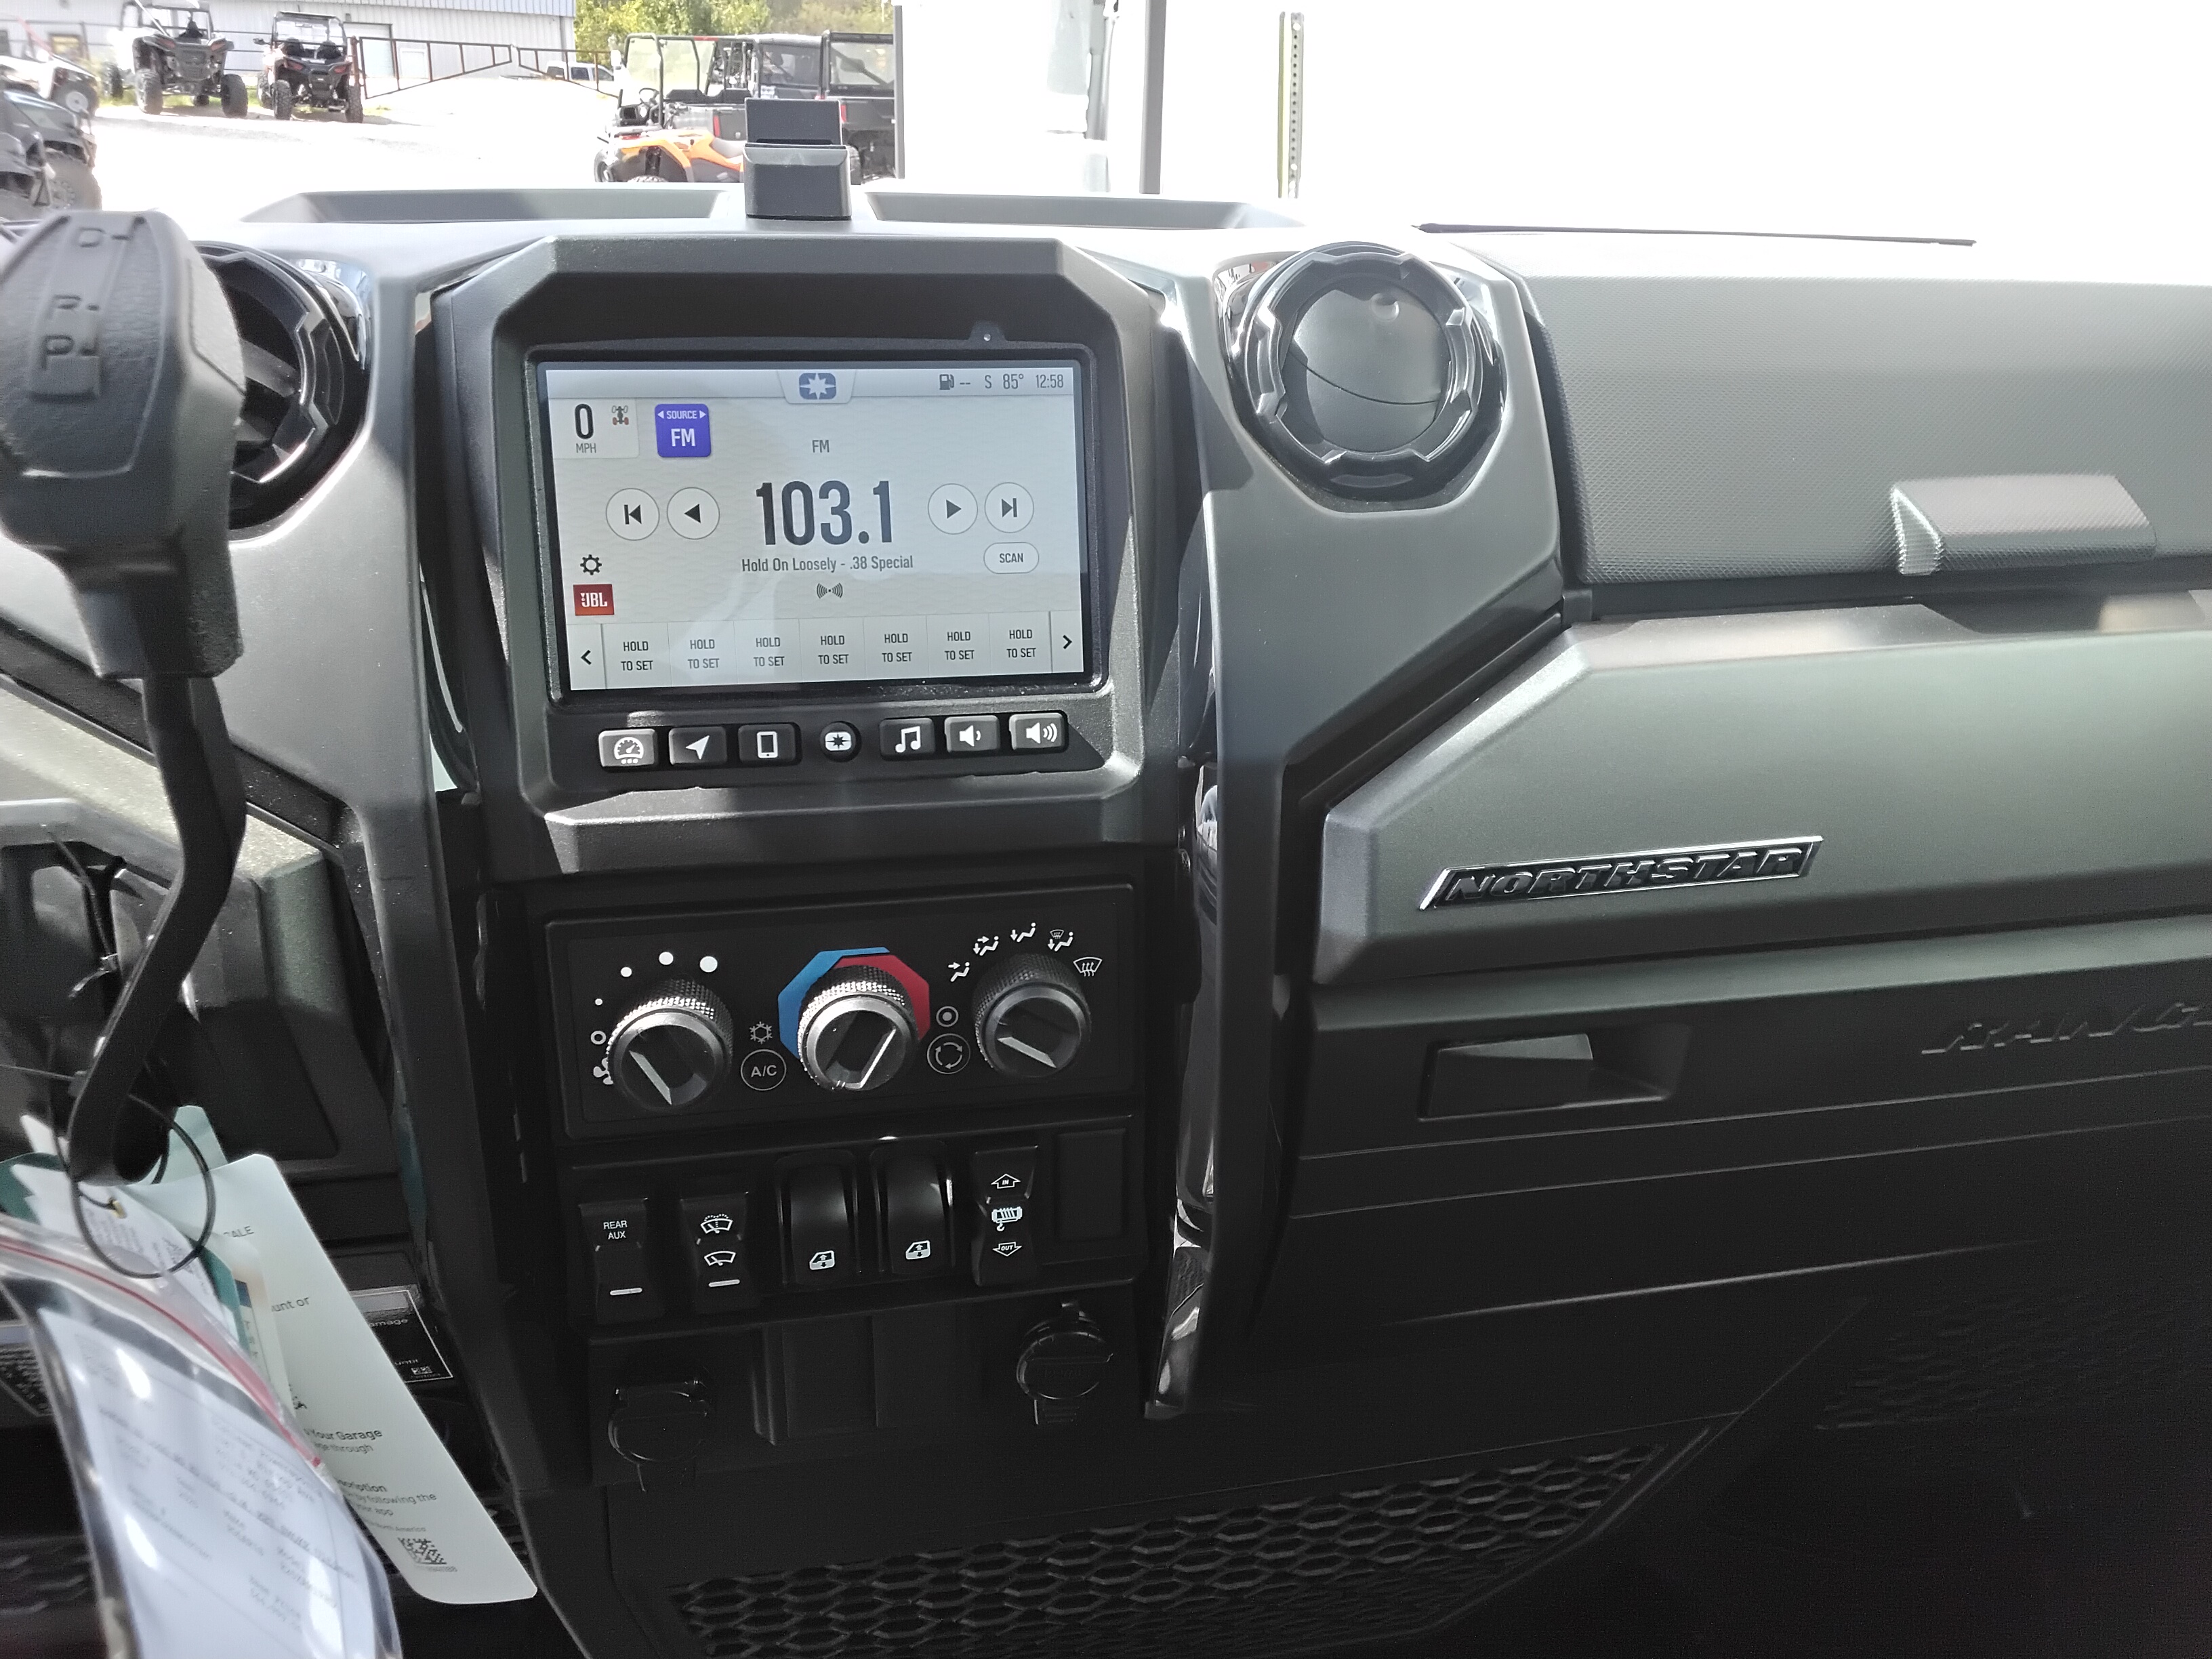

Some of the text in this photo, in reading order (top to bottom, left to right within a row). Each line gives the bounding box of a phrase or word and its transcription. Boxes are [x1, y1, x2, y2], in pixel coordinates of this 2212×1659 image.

[985, 375, 992, 389] S
[1036, 374, 1063, 388] 12:58
[666, 409, 697, 420] SOURCE
[574, 403, 594, 440] 0
[670, 428, 696, 447] FM
[575, 443, 596, 453] MPH
[812, 439, 830, 453] FM
[756, 480, 892, 546] 103.1
[999, 552, 1024, 564] SCAN
[742, 558, 769, 572] Hold
[773, 558, 789, 571] On
[792, 557, 837, 573] Loosely
[849, 556, 867, 569] .38
[871, 555, 914, 571] Special
[884, 633, 908, 644] HOLD
[947, 631, 971, 642] HOLD
[1009, 629, 1033, 640] HOLD
[623, 641, 649, 651] HOLD
[690, 639, 715, 649] HOLD
[756, 637, 781, 648] HOLD
[820, 635, 845, 646] HOLD
[882, 652, 912, 663] TO SET
[945, 650, 975, 661] TO SET
[1006, 648, 1036, 658] TO SET
[688, 658, 720, 669] TO SET
[754, 656, 785, 667] TO SET
[818, 654, 849, 665] TO SET
[621, 660, 653, 671] TO SET
[1445, 847, 1803, 901] NORTHSTAR
[750, 1065, 777, 1078] A/C
[603, 1220, 628, 1230] REAR
[224, 1226, 254, 1237] ALE
[608, 1230, 626, 1240] AUX
[296, 1296, 310, 1307] or
[368, 1319, 408, 1327] amage
[335, 1430, 382, 1440] Garage
[416, 1494, 437, 1502] the
